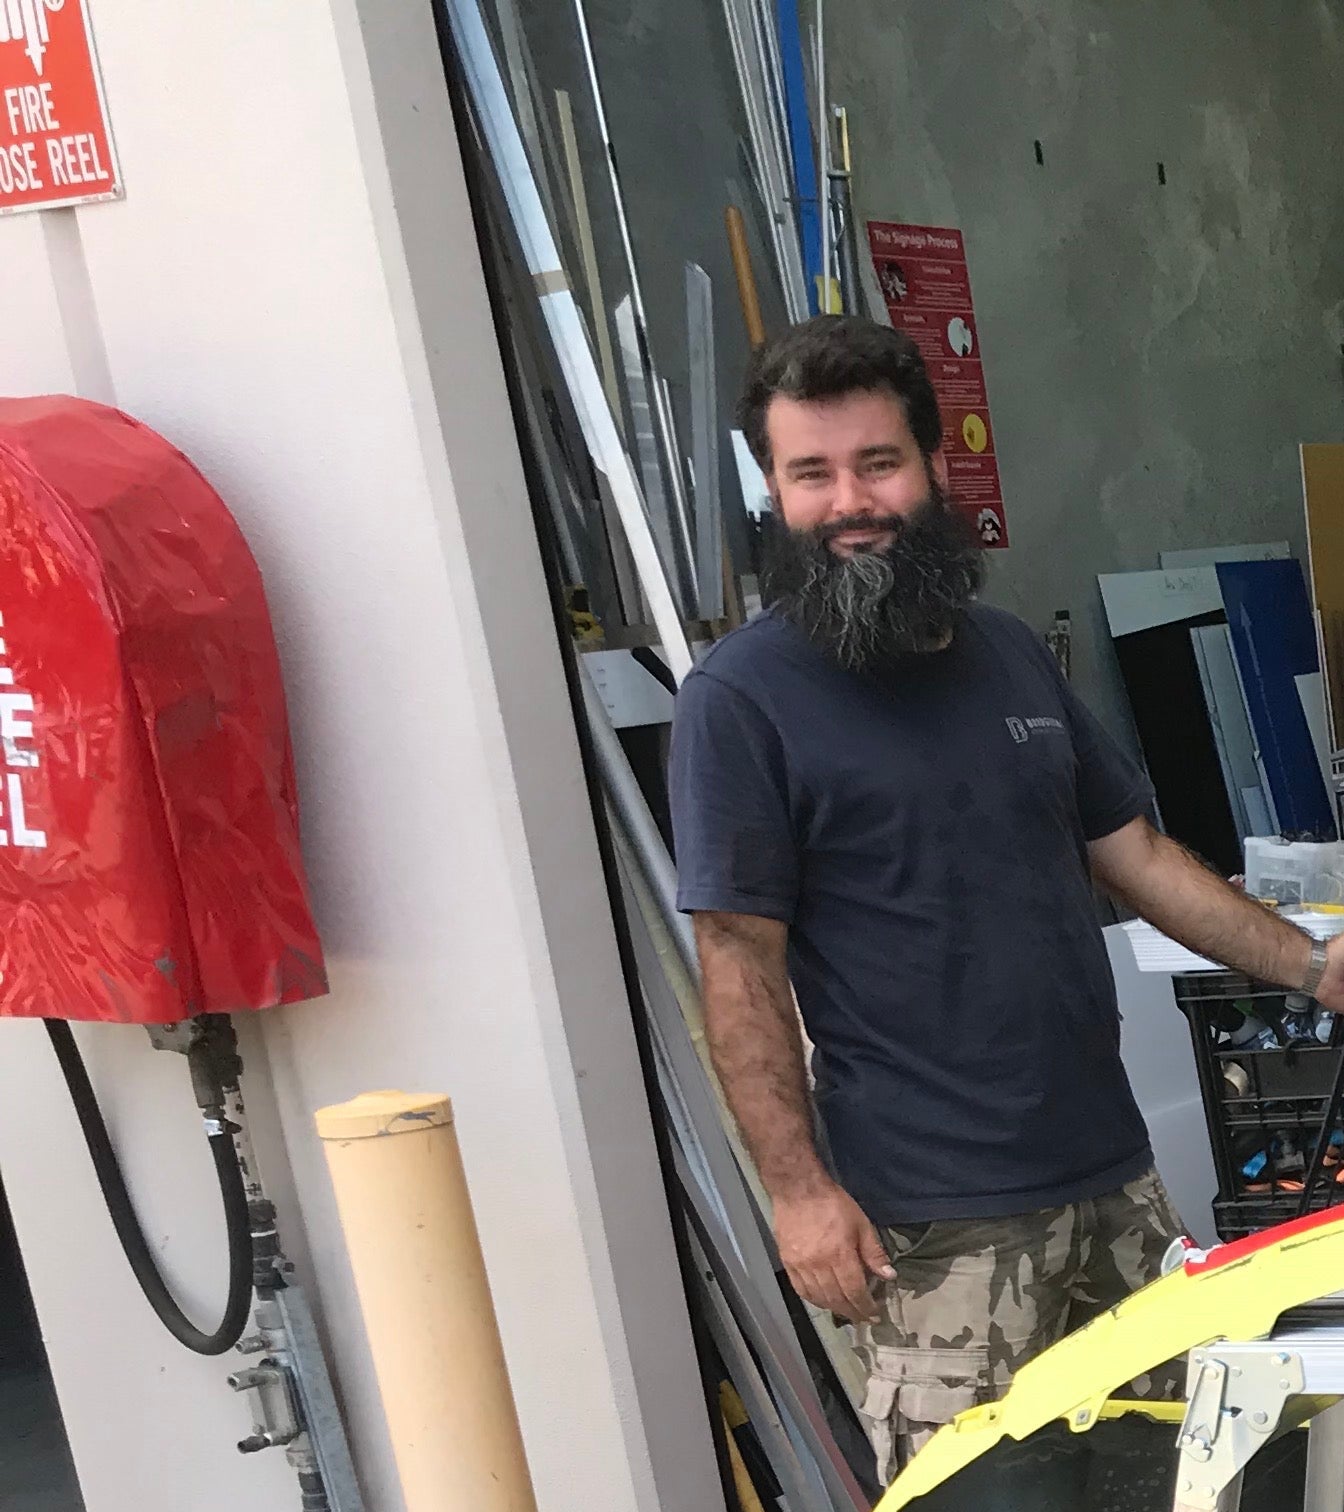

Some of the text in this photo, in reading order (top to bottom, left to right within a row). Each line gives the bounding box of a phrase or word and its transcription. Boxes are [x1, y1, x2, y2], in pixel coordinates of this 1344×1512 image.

[4, 82, 60, 136] FIRE
[0, 132, 109, 194] OSE REEL
[873, 229, 892, 244] The
[927, 233, 958, 250] Process
